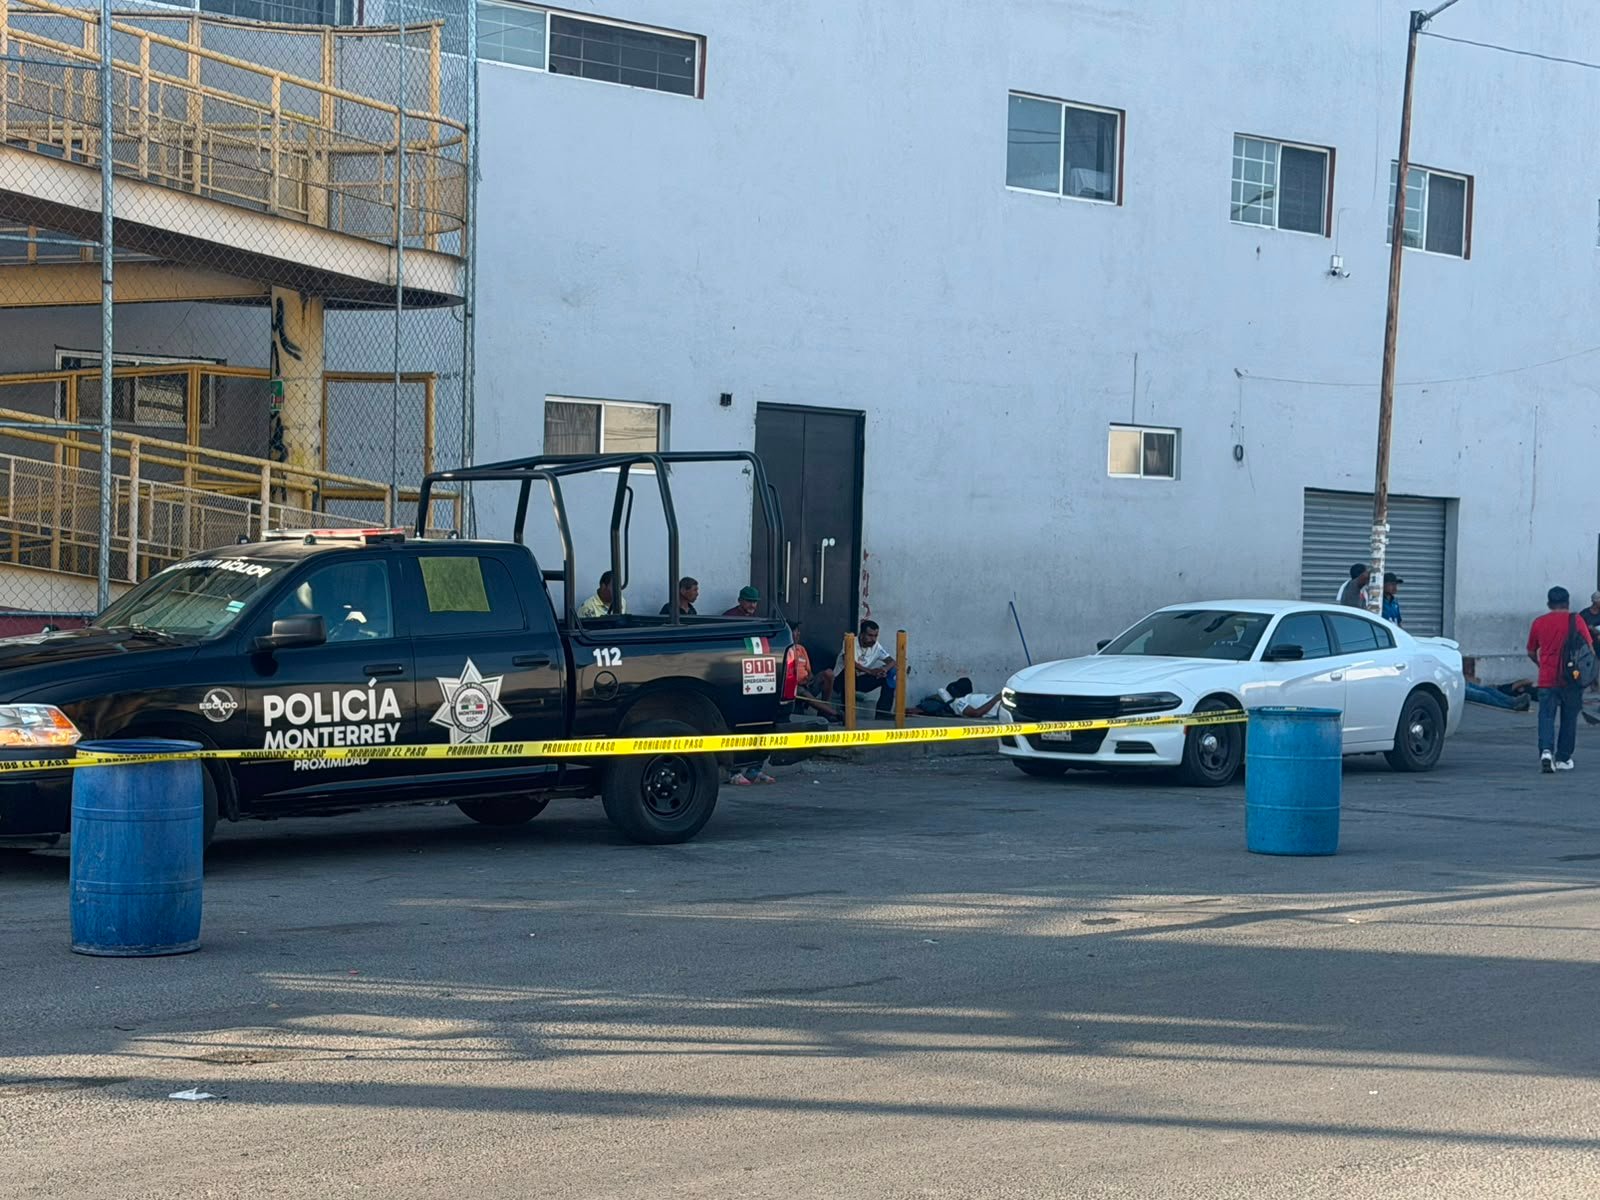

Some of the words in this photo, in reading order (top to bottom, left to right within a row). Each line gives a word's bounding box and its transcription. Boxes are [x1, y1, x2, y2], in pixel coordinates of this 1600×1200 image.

[592, 647, 622, 667] 112
[745, 660, 772, 673] 911
[199, 701, 239, 710] ESCUDO
[263, 677, 401, 727] POLICÍA
[263, 722, 401, 750] MONTERREY
[720, 737, 758, 748] PROHIBIDO
[759, 736, 767, 746] EL
[769, 735, 788, 746] PASO
[804, 733, 840, 744] PROHIBIDO
[841, 733, 849, 743] EL
[851, 732, 870, 742] PASO
[446, 745, 489, 756] PROHIBIDO
[490, 744, 499, 755] EL
[501, 743, 524, 755] PASO
[541, 742, 582, 753] PROHIBIDO
[584, 742, 593, 752] EL
[594, 741, 616, 752] PASO
[632, 739, 672, 750] PROHIBIDO
[673, 739, 682, 750] EL
[683, 738, 704, 749] PASO
[345, 747, 391, 758] PROHIBIDO
[392, 747, 402, 757] EL
[403, 746, 428, 757] PASO
[293, 756, 370, 771] PROXIMIDAD
